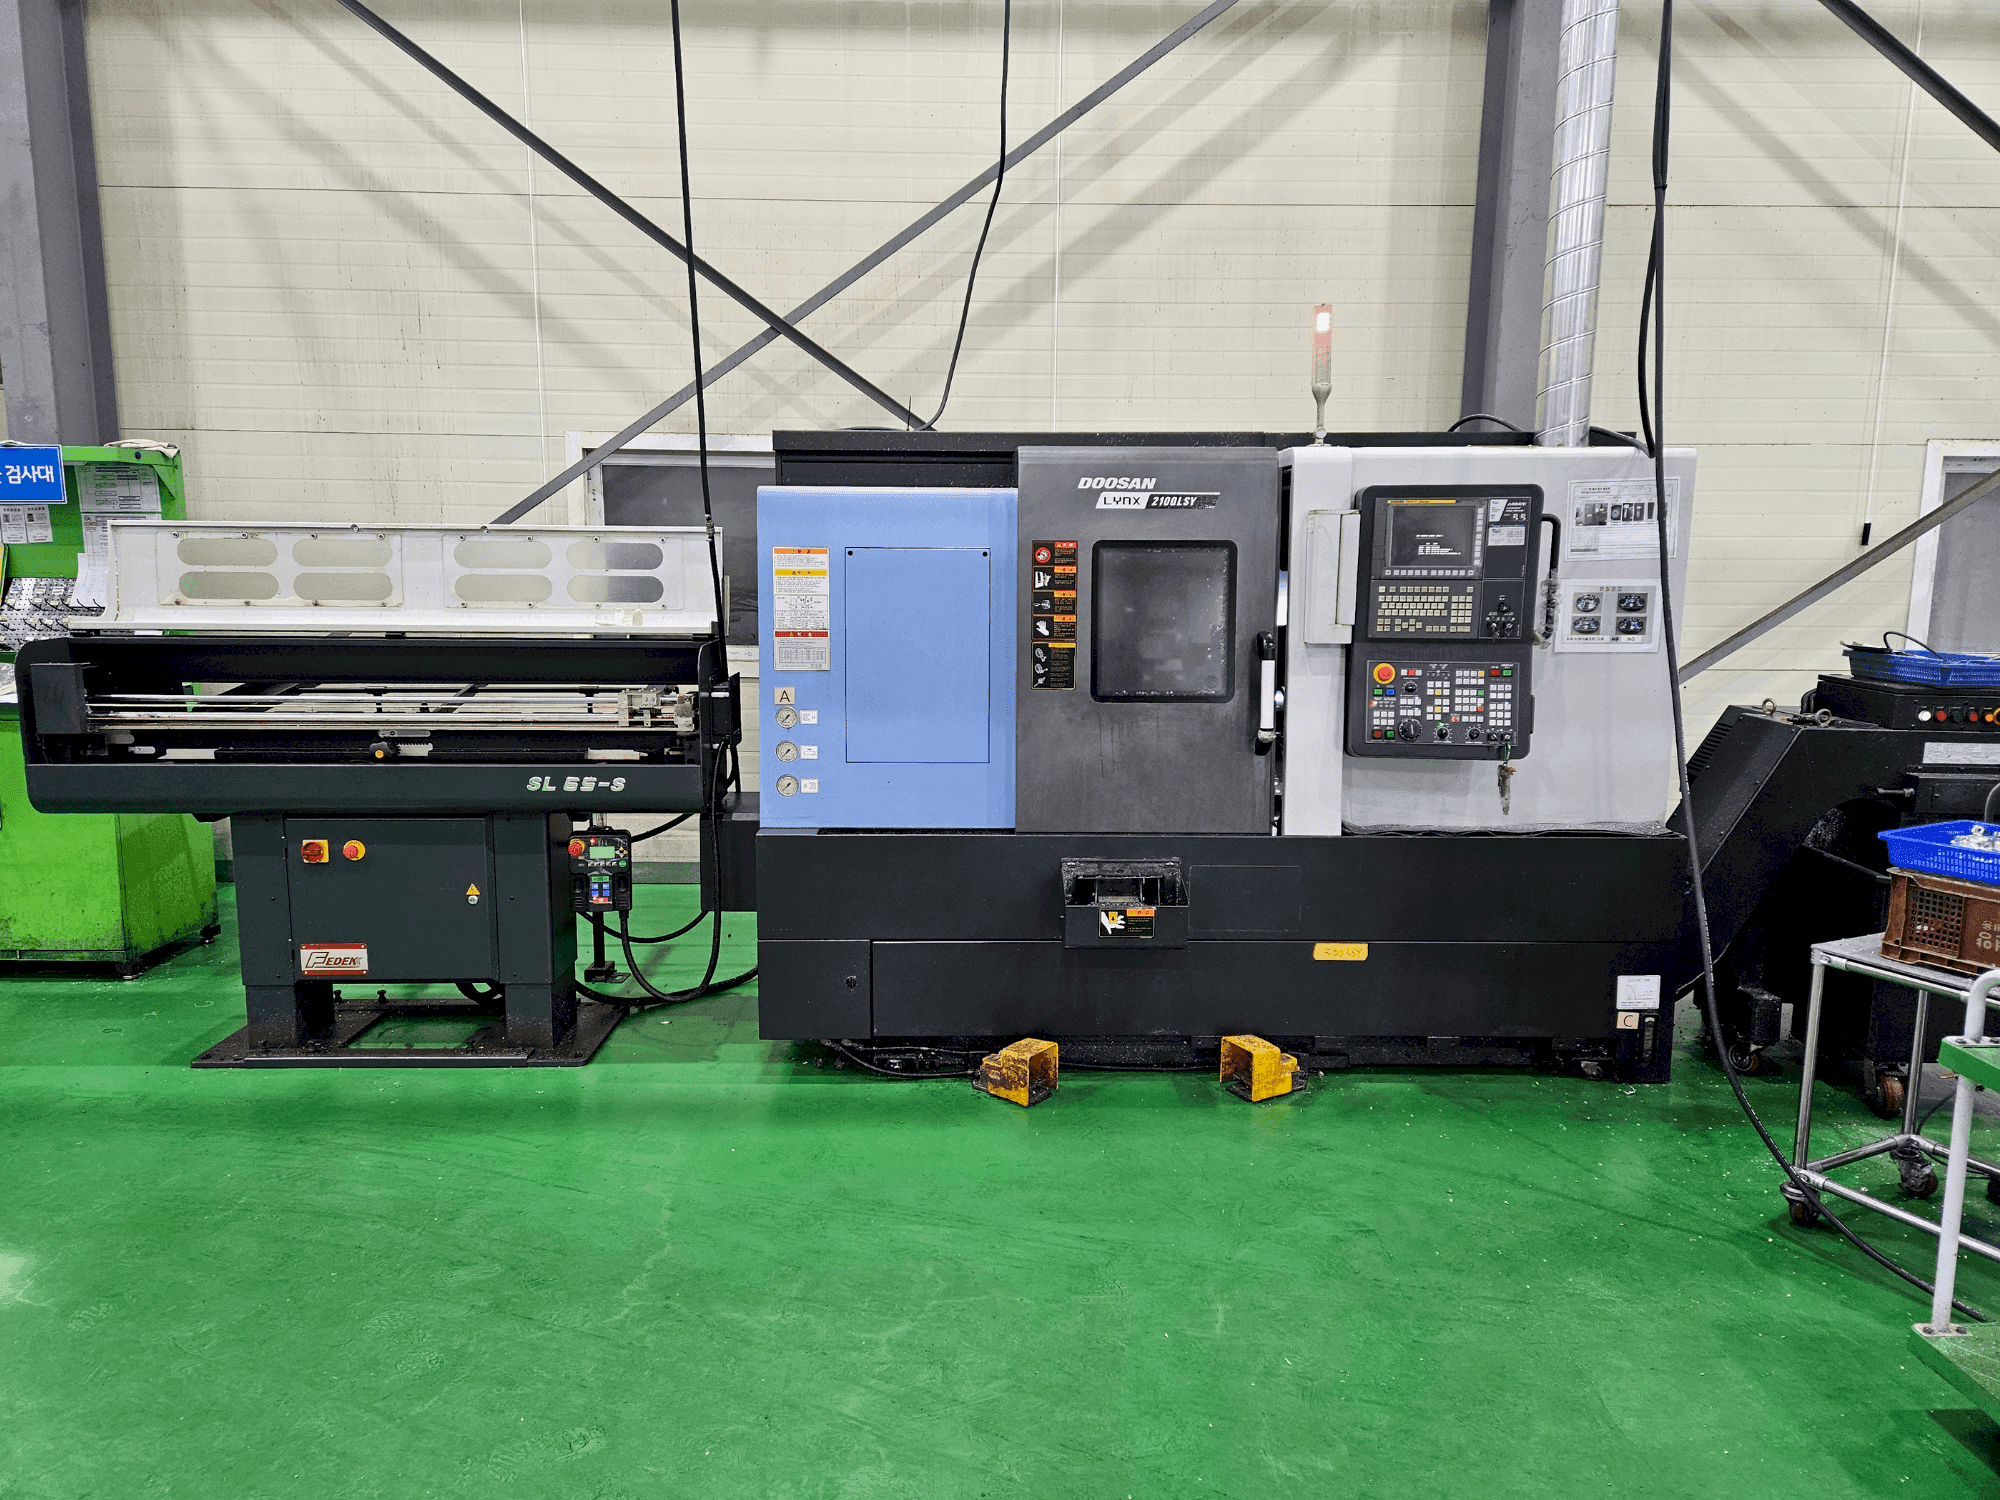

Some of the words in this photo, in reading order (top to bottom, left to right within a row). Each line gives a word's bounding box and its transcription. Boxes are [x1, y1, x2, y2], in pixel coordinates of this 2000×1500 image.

[4, 464, 55, 485] 검사대
[1077, 477, 1157, 490] DOOSAN
[1151, 496, 1198, 507] 2100LSY
[779, 689, 791, 703] A
[526, 776, 557, 792] SL
[563, 776, 626, 792] 65-S
[305, 951, 363, 969] FEDEK
[1623, 1014, 1633, 1027] C
